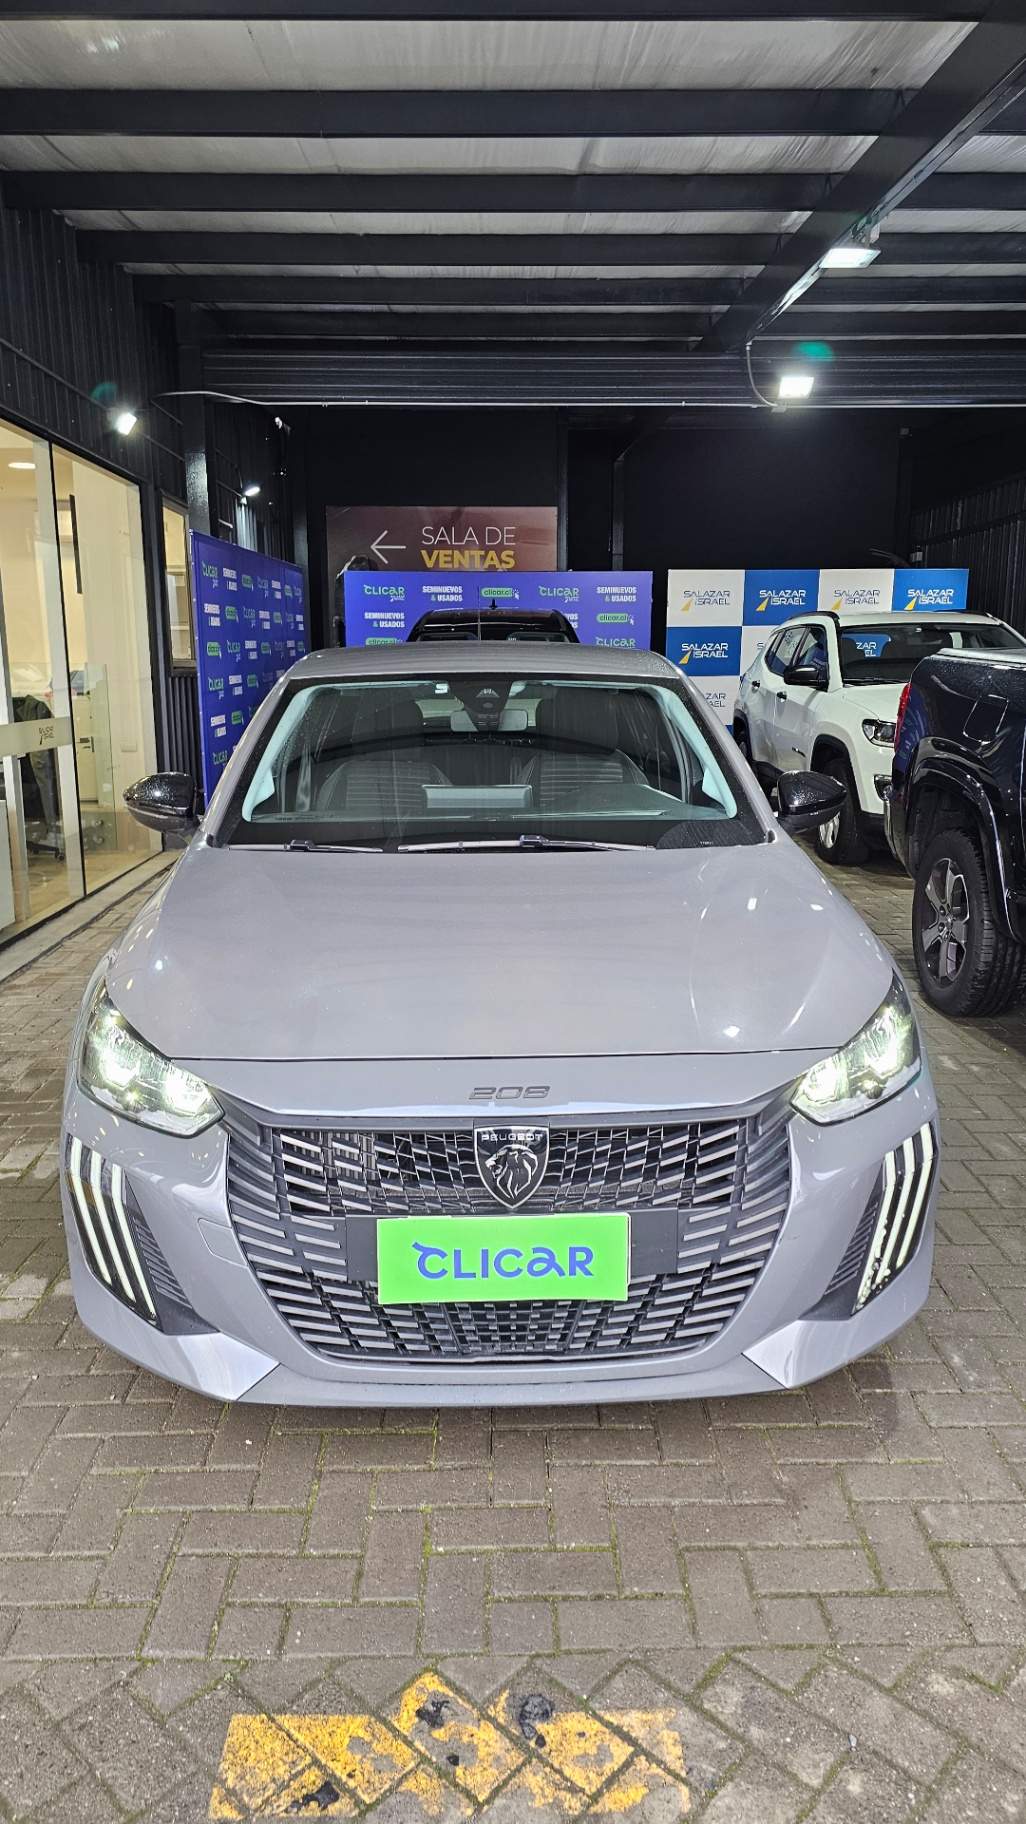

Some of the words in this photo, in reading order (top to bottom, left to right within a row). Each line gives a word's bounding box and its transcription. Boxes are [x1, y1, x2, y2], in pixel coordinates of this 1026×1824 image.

[421, 526, 479, 545] SALA
[485, 526, 517, 545] DE
[420, 550, 516, 569] VENTAS
[363, 584, 405, 597] CLICAR
[422, 585, 463, 593] SEMINUEVOS
[538, 585, 580, 597] CLICAR
[596, 586, 637, 594] SEMINUEVOS
[759, 589, 806, 598] SALAZAR
[834, 589, 881, 598] SALAZAR
[907, 588, 954, 597] SALAZAR
[437, 594, 463, 602] USADOS
[683, 590, 731, 598] SALAZAR
[611, 595, 637, 603] USADOS
[694, 598, 731, 606] ISRAEL
[771, 597, 806, 606] ISRAEL
[845, 597, 880, 605] ISRAEL
[918, 596, 953, 605] ISRAEL
[681, 642, 729, 651] SALAZAR
[692, 650, 728, 658] ISRAEL
[468, 1085, 551, 1100] 208
[481, 1132, 544, 1142] PEUGEOT
[411, 1241, 595, 1280] CLICAR
